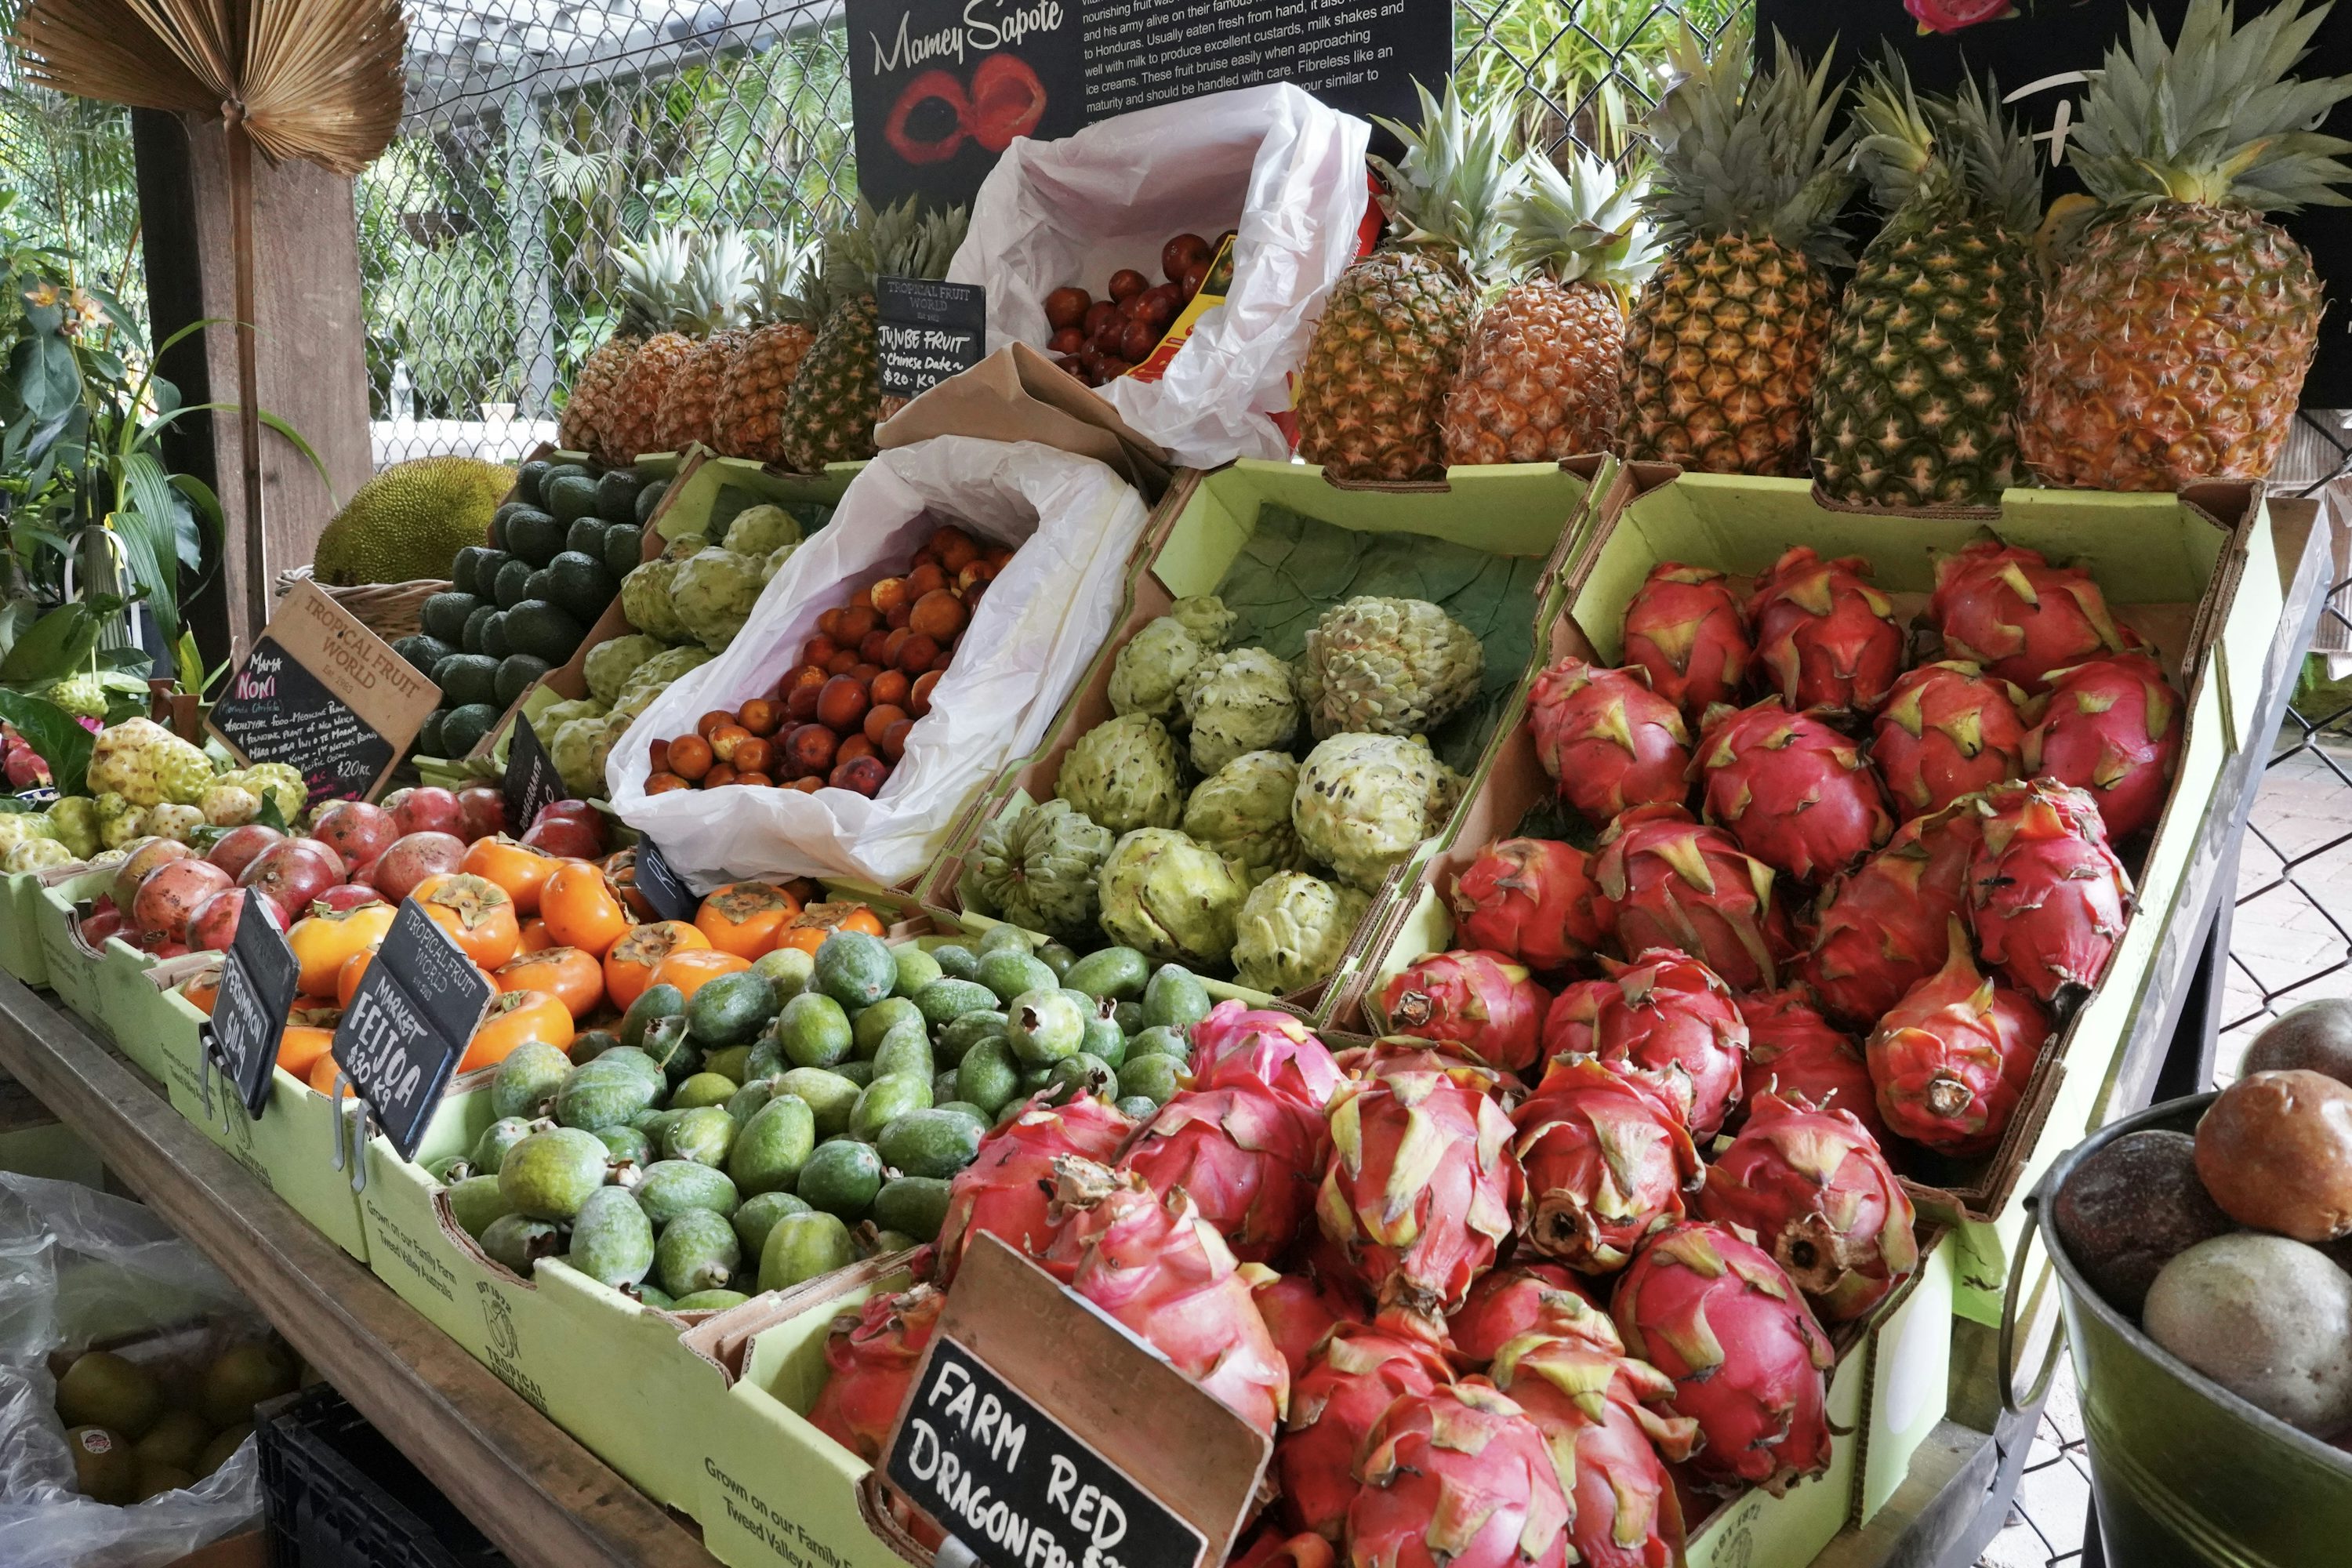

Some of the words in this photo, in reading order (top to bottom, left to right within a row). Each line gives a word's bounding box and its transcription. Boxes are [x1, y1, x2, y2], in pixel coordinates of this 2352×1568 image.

[869, 10, 964, 75] Mamey
[964, 0, 1063, 49] Sapote
[1083, 4, 1131, 24] nourishing
[1134, 0, 1152, 12] fruit
[1083, 28, 1102, 42] and
[1103, 25, 1117, 38] his
[1120, 20, 1144, 35] army
[1146, 13, 1169, 27] alive
[1172, 10, 1185, 22] on
[1187, 4, 1210, 18] their
[1084, 49, 1093, 60] to
[1095, 39, 1144, 57] Honduras.
[1147, 28, 1183, 45] Usually
[1186, 22, 1214, 38] eaten
[1218, 14, 1244, 31] fresh
[1247, 11, 1272, 24] from
[1276, 1, 1307, 18] hand,
[1311, 0, 1318, 10] it
[1085, 64, 1103, 77] well
[1105, 60, 1124, 73] with
[1127, 55, 1146, 69] milk
[1149, 52, 1158, 64] to
[1161, 45, 1202, 64] produce
[1204, 33, 1251, 52] excellent
[1254, 23, 1305, 42] custards,
[1308, 16, 1331, 31] milk
[1334, 7, 1377, 26] shakes
[1381, 0, 1404, 16] and
[1086, 83, 1099, 95] ice
[1102, 77, 1139, 92] creams.
[1142, 69, 1172, 84] These
[1175, 64, 1193, 78] fruit
[1197, 57, 1229, 74] bruise
[1232, 49, 1261, 67] easily
[1265, 45, 1294, 60] when
[1298, 29, 1370, 55] approaching
[1087, 96, 1123, 113] maturity
[1126, 92, 1144, 106] and
[1146, 85, 1179, 101] should
[1181, 82, 1194, 95] be
[1197, 73, 1239, 92] handled
[1242, 70, 1263, 83] with
[1266, 66, 1294, 78] care.
[1298, 54, 1350, 73] Fibreless
[1353, 49, 1374, 64] like
[1377, 45, 1393, 59] an
[1326, 71, 1363, 89] similar
[1367, 69, 1378, 82] to
[887, 281, 938, 297] TROPICAL
[940, 287, 971, 301] FRUIT
[909, 297, 948, 311] WORLD
[878, 325, 921, 350] JUJUBE
[924, 331, 971, 354] FRUIT
[249, 652, 283, 674] MAMA
[304, 596, 372, 662] TROPICAL
[372, 654, 420, 699] FRUIT
[322, 637, 376, 689] WORLD
[237, 672, 276, 700] NONI
[406, 909, 449, 971] TROPICAL
[445, 956, 477, 998] FRUIT
[415, 947, 448, 993] WORLD
[226, 958, 262, 1044] PERSIMMON
[375, 975, 428, 1045] MARKET
[347, 1044, 371, 1084] $30
[349, 991, 421, 1108] FEIJOA
[367, 1200, 390, 1229] Grown
[390, 1222, 400, 1239] on
[401, 1232, 412, 1248] our
[412, 1239, 436, 1272] Family
[436, 1258, 457, 1285] Farm
[378, 1228, 401, 1258] Tweed
[400, 1248, 420, 1278] Valley
[421, 1265, 454, 1302] Australia
[476, 1280, 490, 1294] EST
[485, 1345, 546, 1402] TROPICAL
[492, 1361, 516, 1388] FRUIT
[516, 1381, 548, 1412] WORLD
[928, 1361, 1026, 1474] FARM
[1047, 1454, 1127, 1550] RED
[705, 1457, 749, 1502] Grown
[751, 1495, 768, 1517] on
[771, 1510, 794, 1536] our
[797, 1524, 841, 1568] Family
[909, 1417, 1074, 1568] DRAGONFR
[723, 1495, 764, 1541] Tweed
[766, 1527, 804, 1568] Valley
